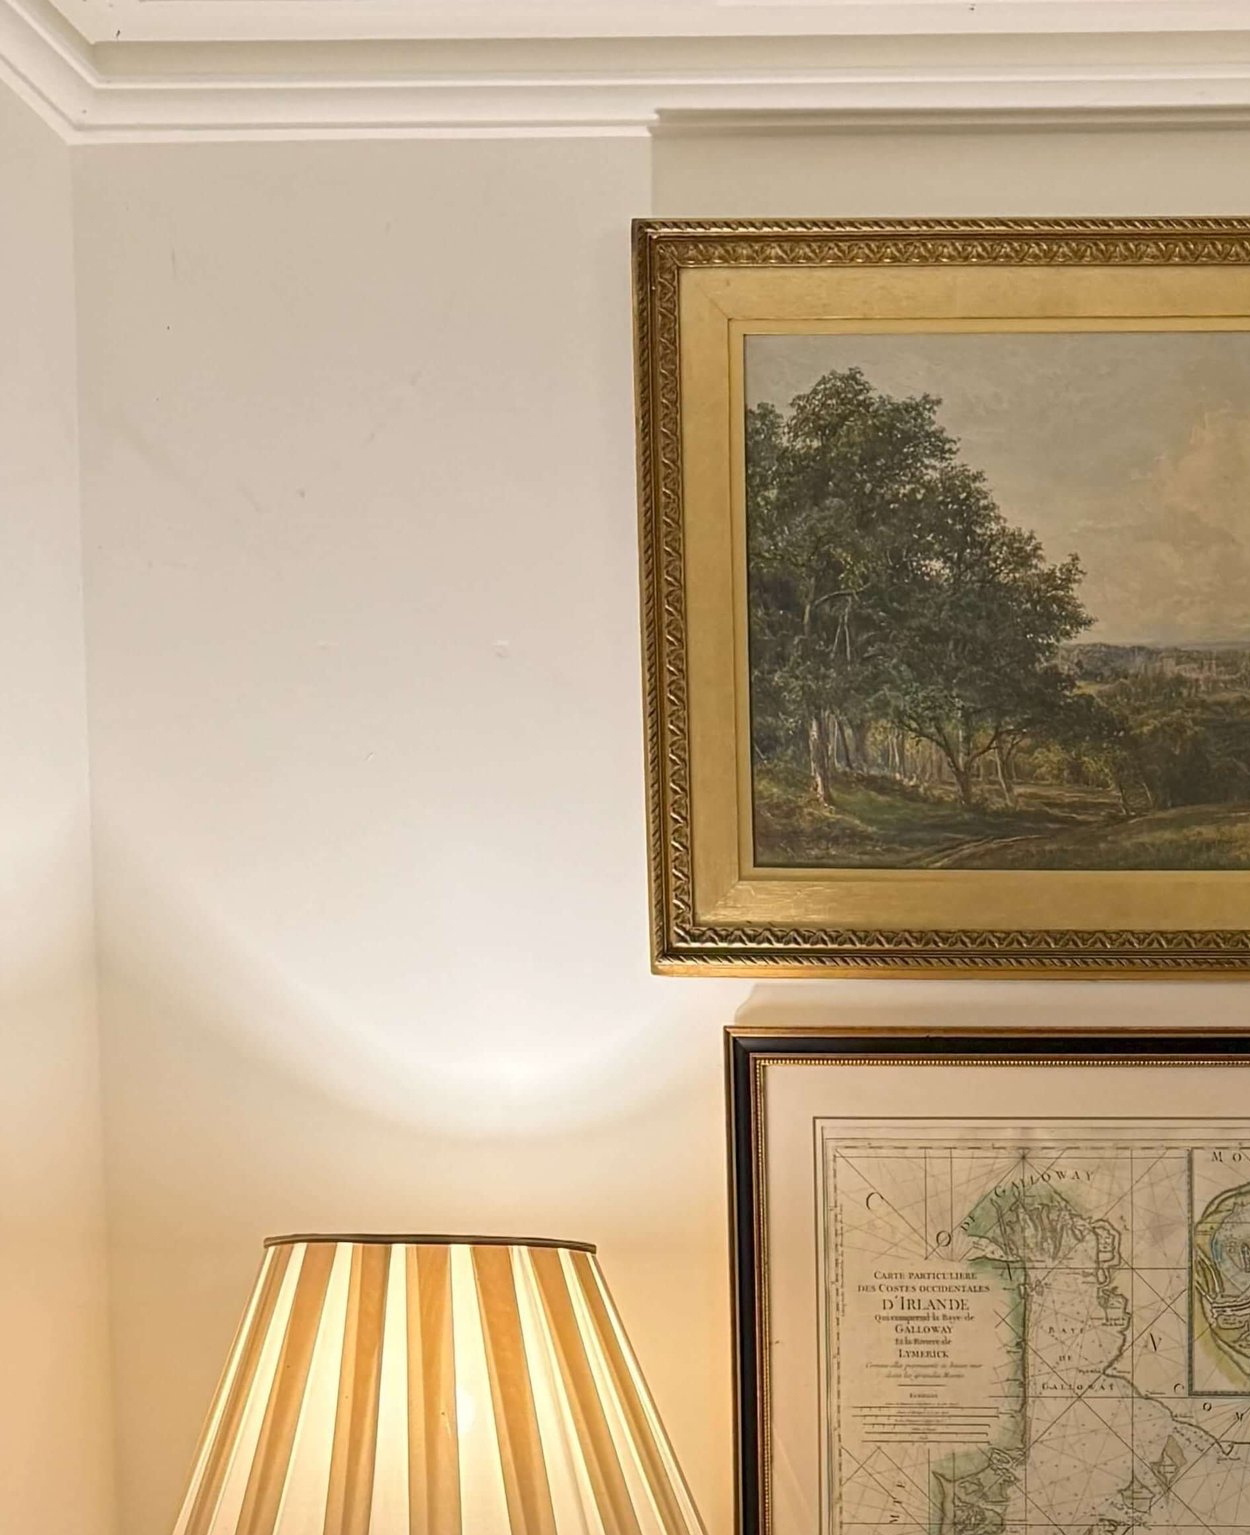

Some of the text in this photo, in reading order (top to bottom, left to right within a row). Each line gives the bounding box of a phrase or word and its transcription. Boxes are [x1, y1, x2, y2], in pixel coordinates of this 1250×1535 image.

[994, 1170, 1094, 1198] GALLOWAY
[874, 1271, 905, 1280] CARTE
[858, 1284, 990, 1293] DES COSTES OCCIDENTALES
[895, 1325, 954, 1334] GALLOWAY
